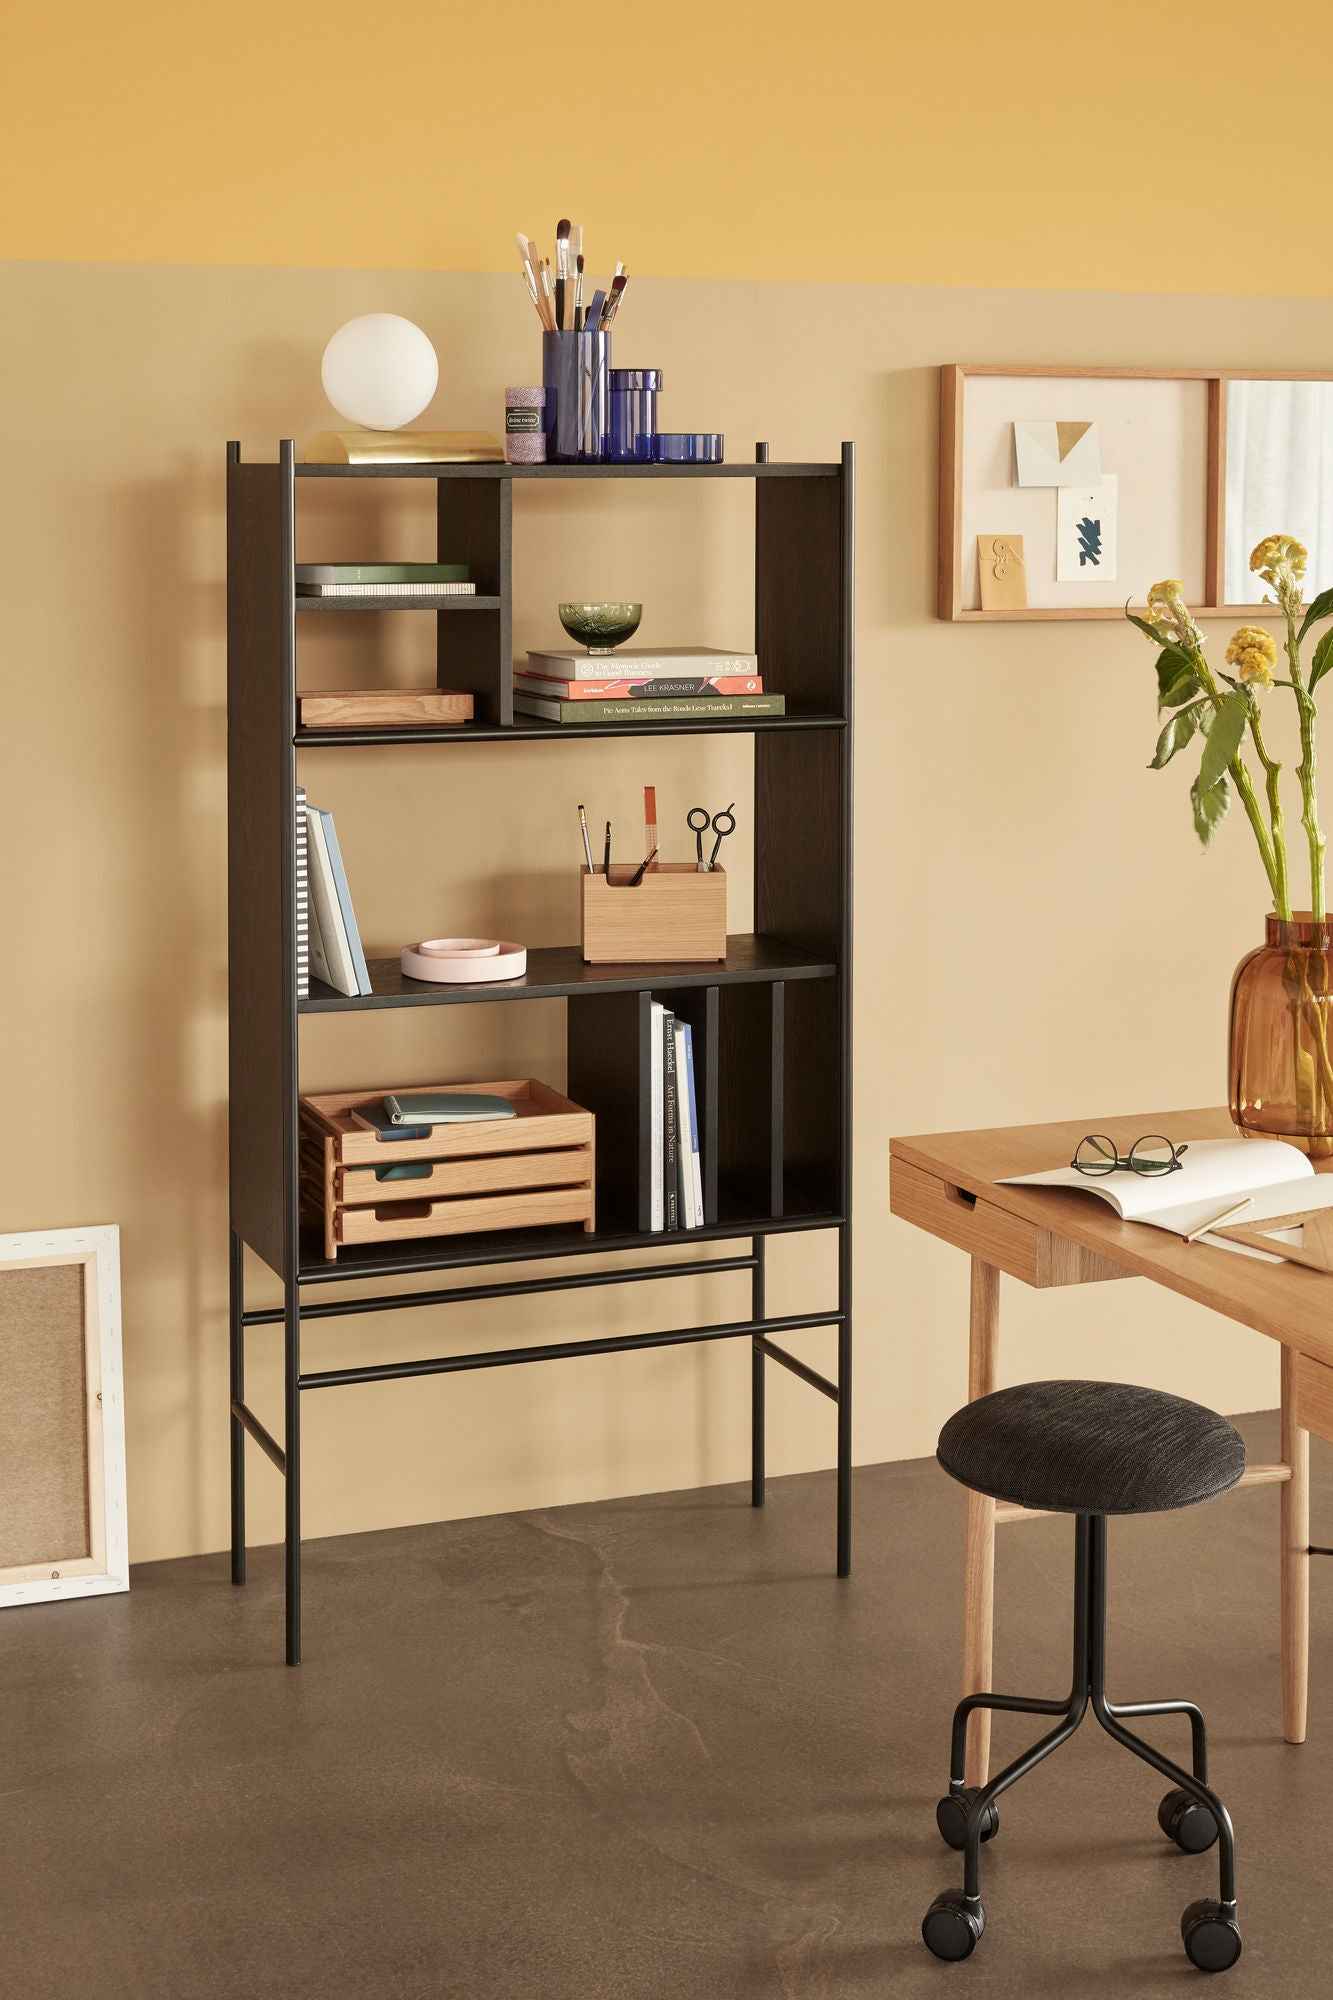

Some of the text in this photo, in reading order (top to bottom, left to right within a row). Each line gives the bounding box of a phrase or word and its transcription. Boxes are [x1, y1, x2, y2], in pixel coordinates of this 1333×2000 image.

[659, 683, 695, 691] KRASNER
[631, 705, 647, 713] Tales
[647, 704, 662, 713] from
[662, 704, 672, 712] the
[667, 1042, 675, 1074] Haeckel
[667, 1100, 675, 1124] Forms
[668, 1126, 675, 1134] in
[668, 1135, 676, 1163] Nature
